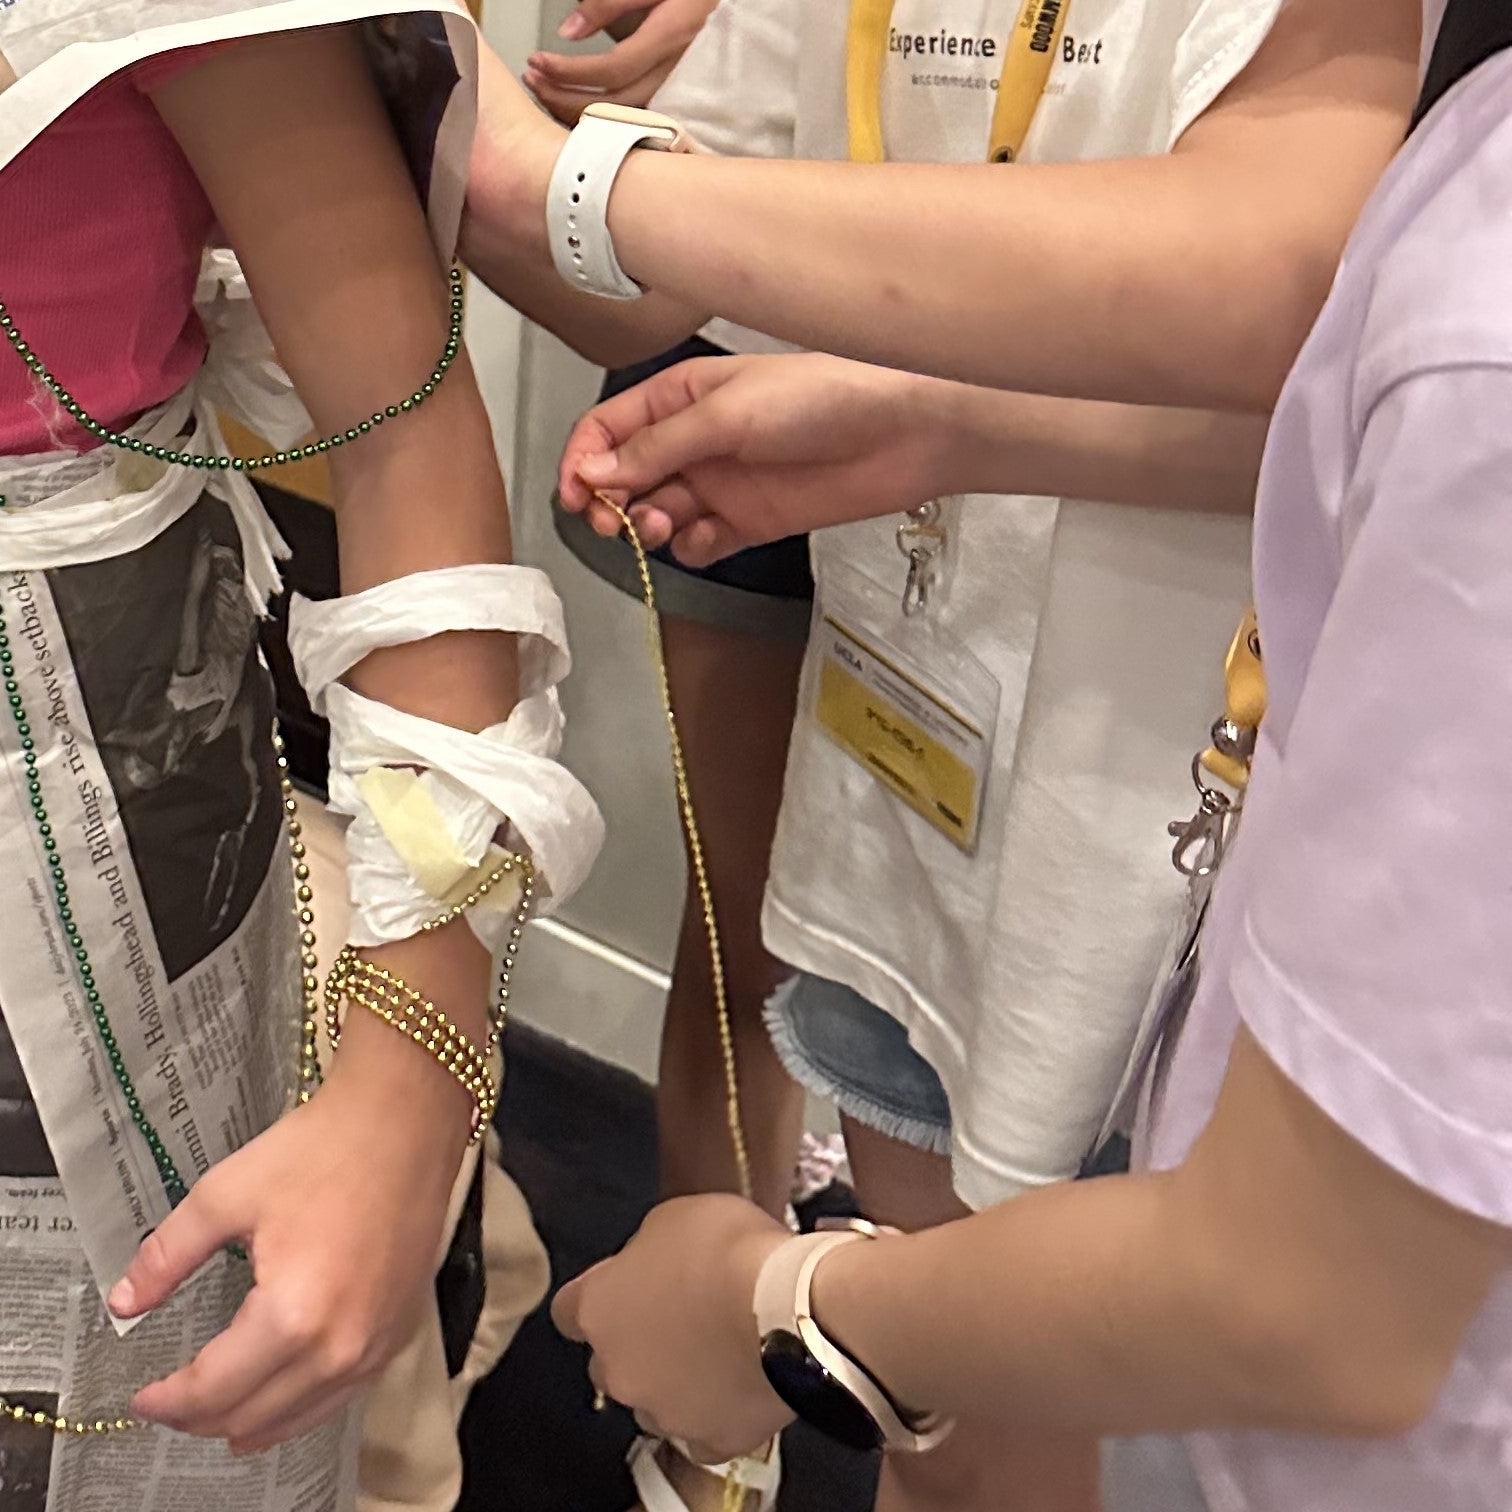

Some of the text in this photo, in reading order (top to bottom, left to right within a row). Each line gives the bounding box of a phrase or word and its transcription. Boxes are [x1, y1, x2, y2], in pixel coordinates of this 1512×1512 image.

[889, 29, 1103, 64] Experience Best
[41, 663, 70, 729] above
[61, 734, 85, 776] rise
[78, 779, 115, 865] Billings
[97, 865, 128, 907] and
[113, 912, 166, 1049] Hollingshead
[156, 1041, 188, 1120] Brady,
[116, 1158, 135, 1194] BRUIN
